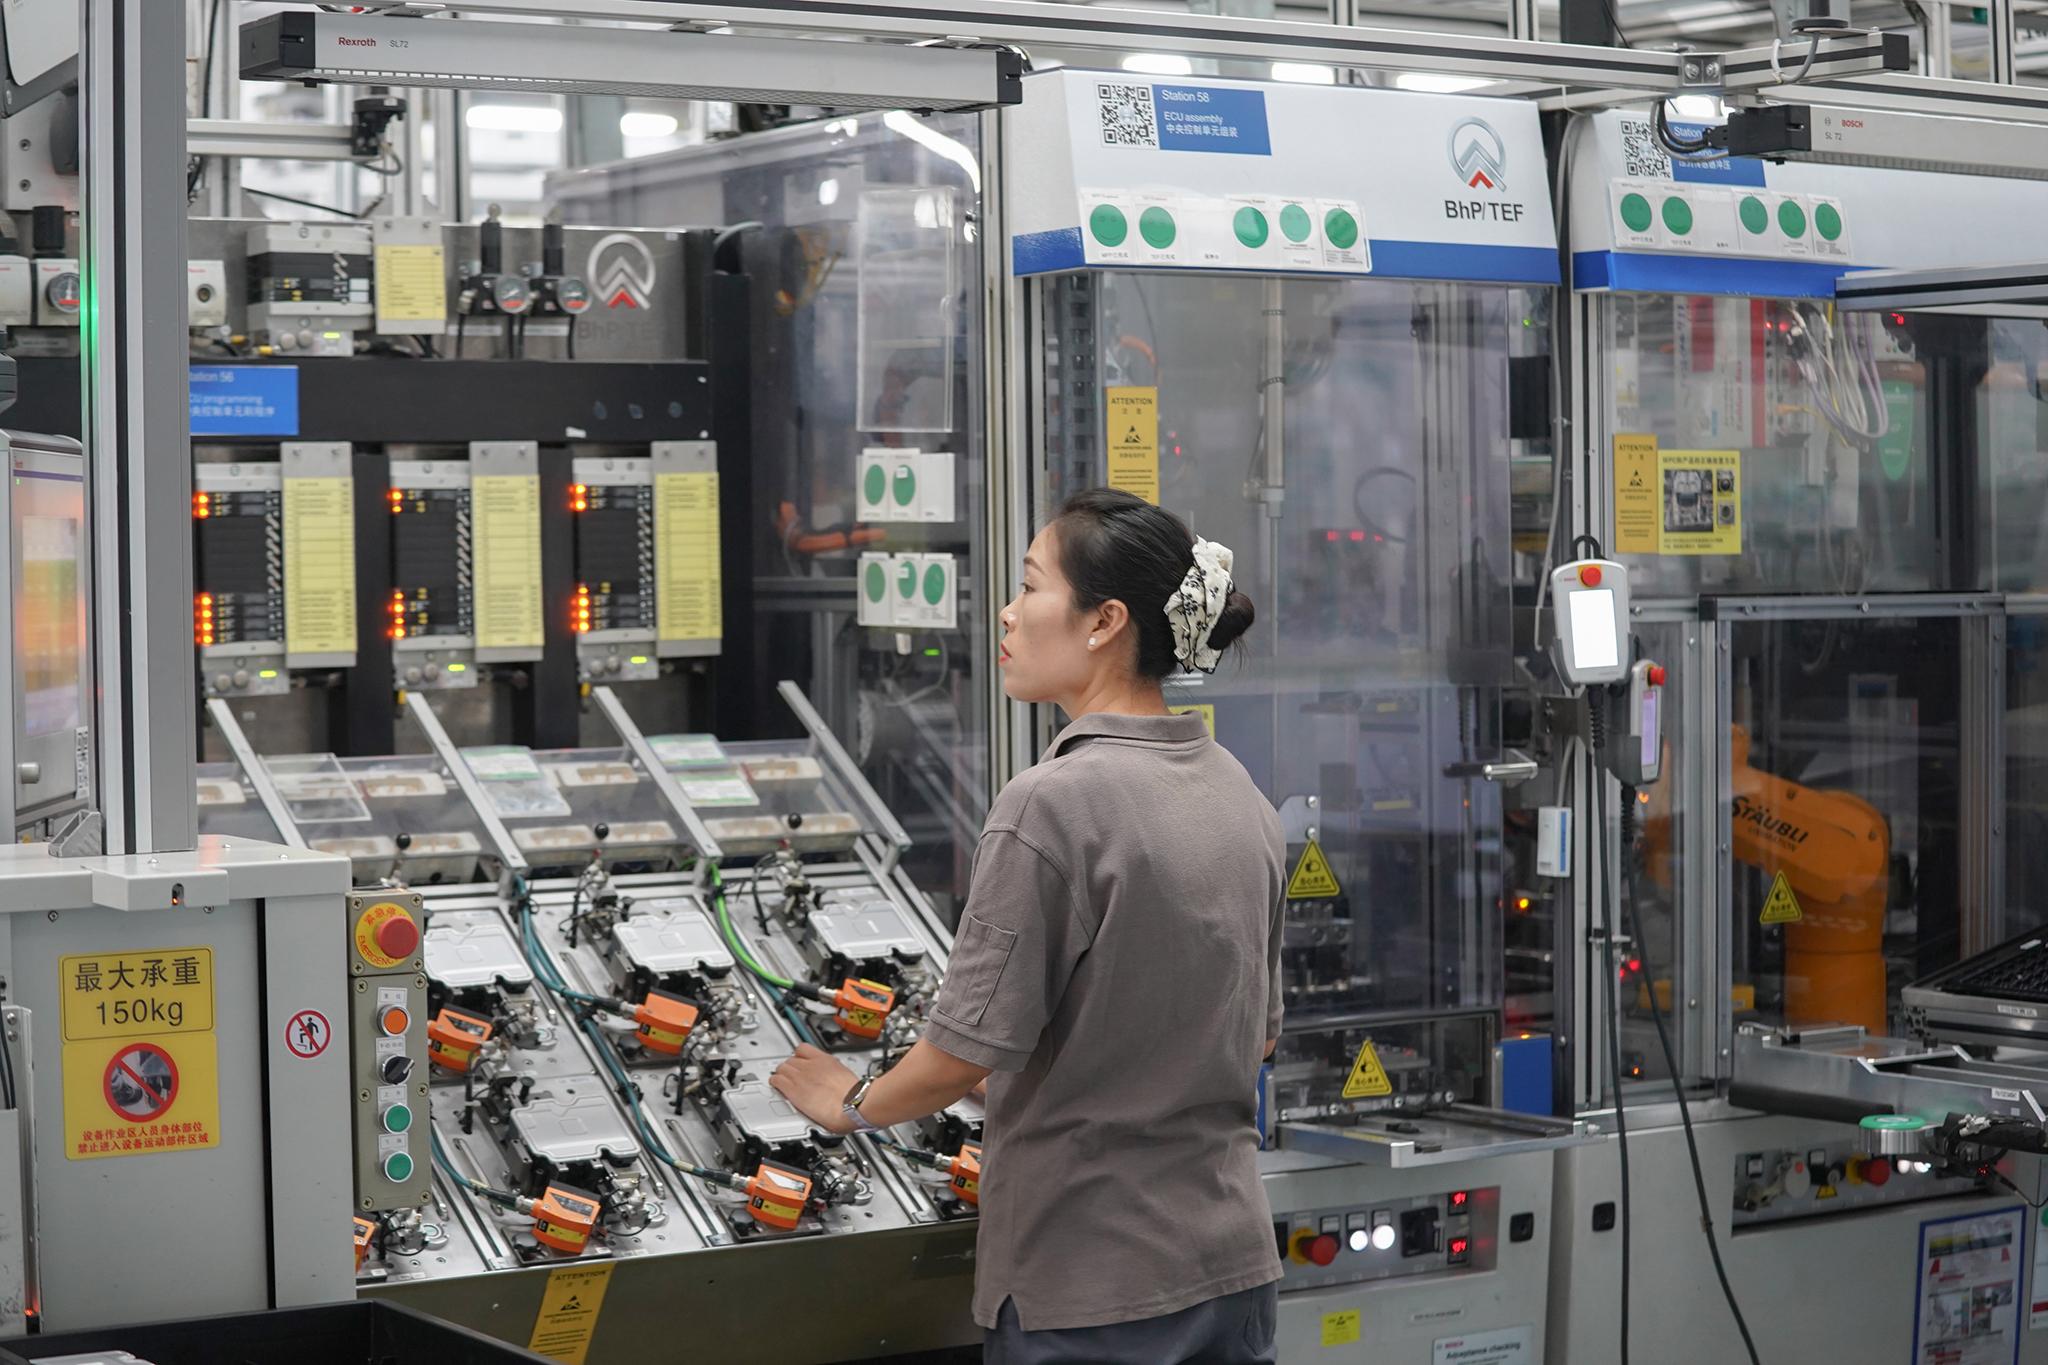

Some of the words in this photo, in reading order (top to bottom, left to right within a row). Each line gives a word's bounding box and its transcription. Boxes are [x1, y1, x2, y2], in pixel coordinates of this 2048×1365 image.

[338, 36, 376, 47] Rexroth
[1162, 89, 1196, 102] Station
[1197, 91, 1210, 103] 58
[1164, 111, 1184, 121] ECU
[1185, 114, 1223, 125] assembly
[1841, 119, 1863, 128] BOSCH
[1166, 123, 1238, 137] 中央控制单元组装
[1674, 126, 1703, 138] Station
[1111, 397, 1153, 406] ATTENTION
[1619, 444, 1653, 452] ATTENTION
[1732, 795, 1808, 843] STÄUBLI
[358, 935, 399, 966] EMERGENC
[75, 956, 201, 993] 最大承重
[96, 998, 183, 1027] 150kg
[82, 1121, 203, 1142] 设备作业区人员身体部位
[77, 1132, 209, 1154] 禁止进入设备运动部件区域
[555, 1270, 606, 1281] ATTENTION
